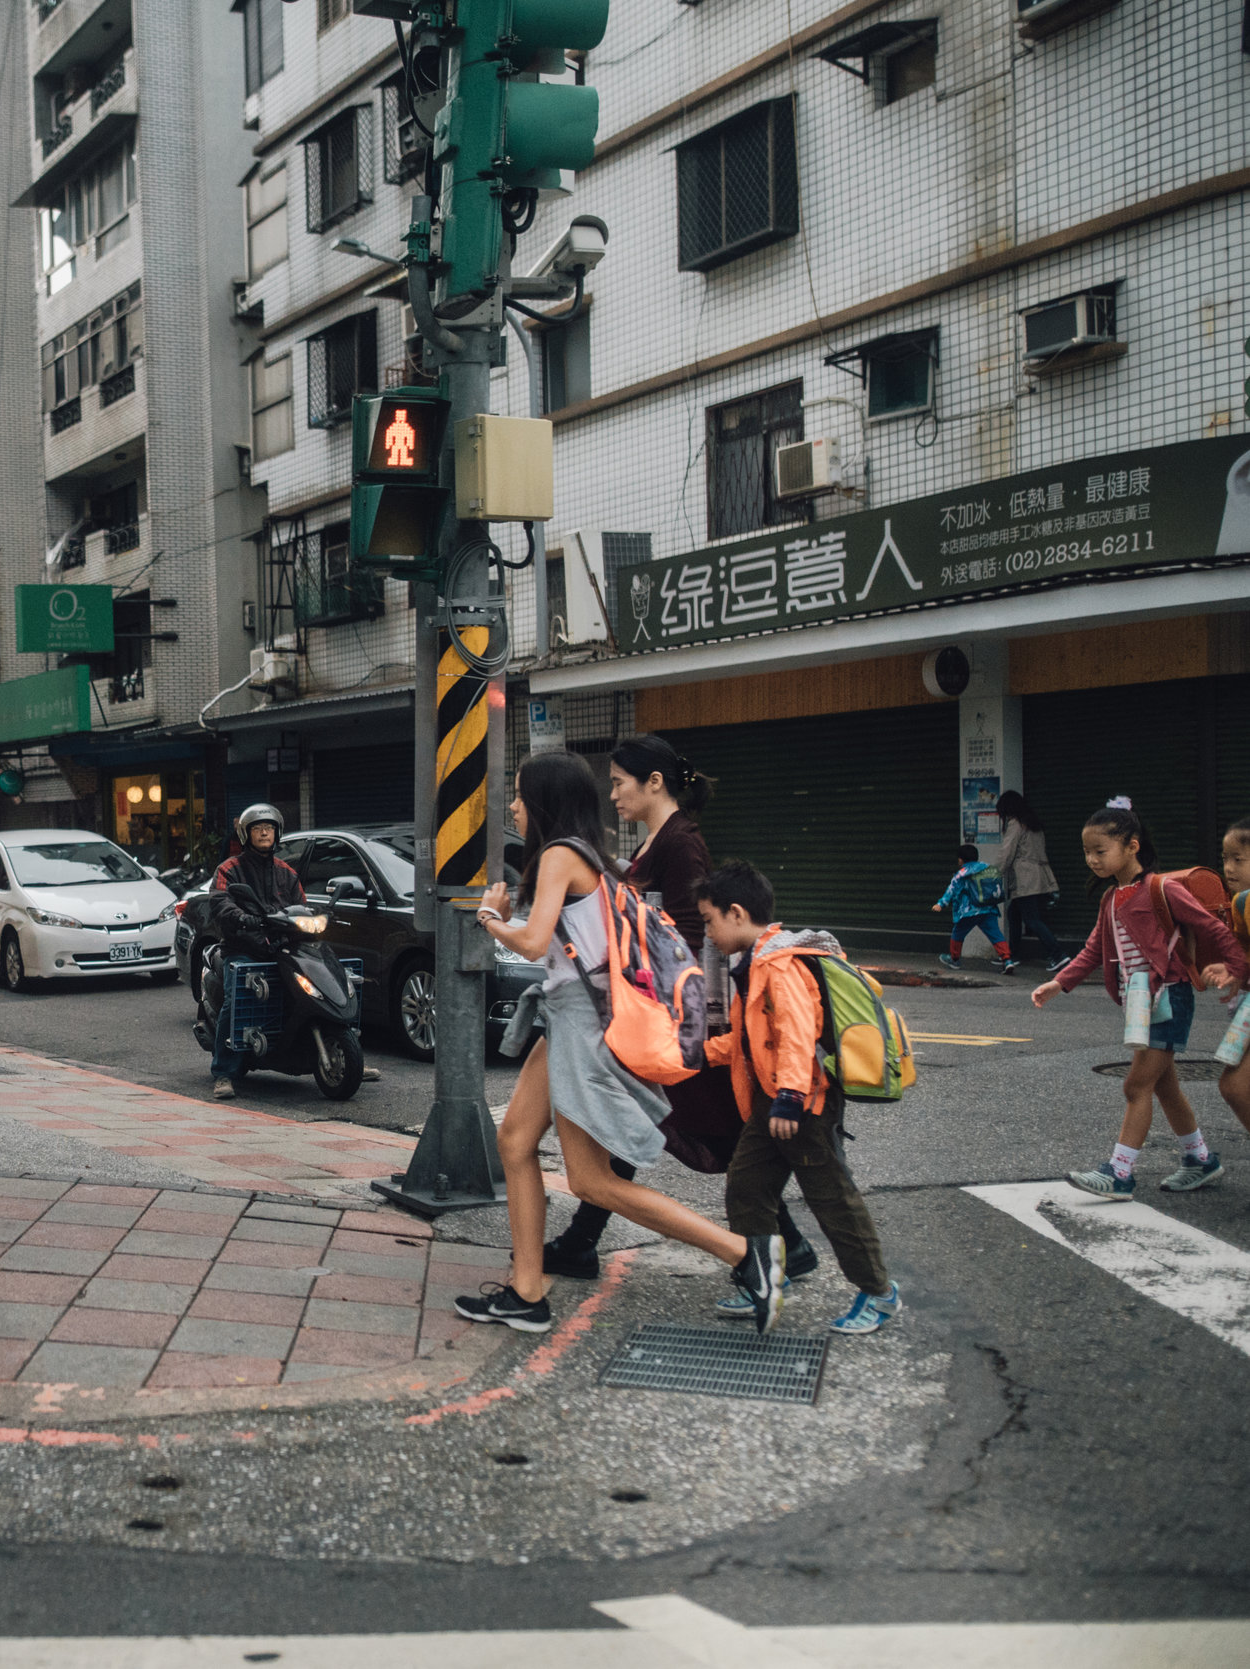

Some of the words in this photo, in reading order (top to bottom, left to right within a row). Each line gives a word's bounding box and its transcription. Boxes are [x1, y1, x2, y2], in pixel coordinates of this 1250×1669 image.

[660, 519, 923, 637] 綠逗薏人
[532, 703, 544, 720] P
